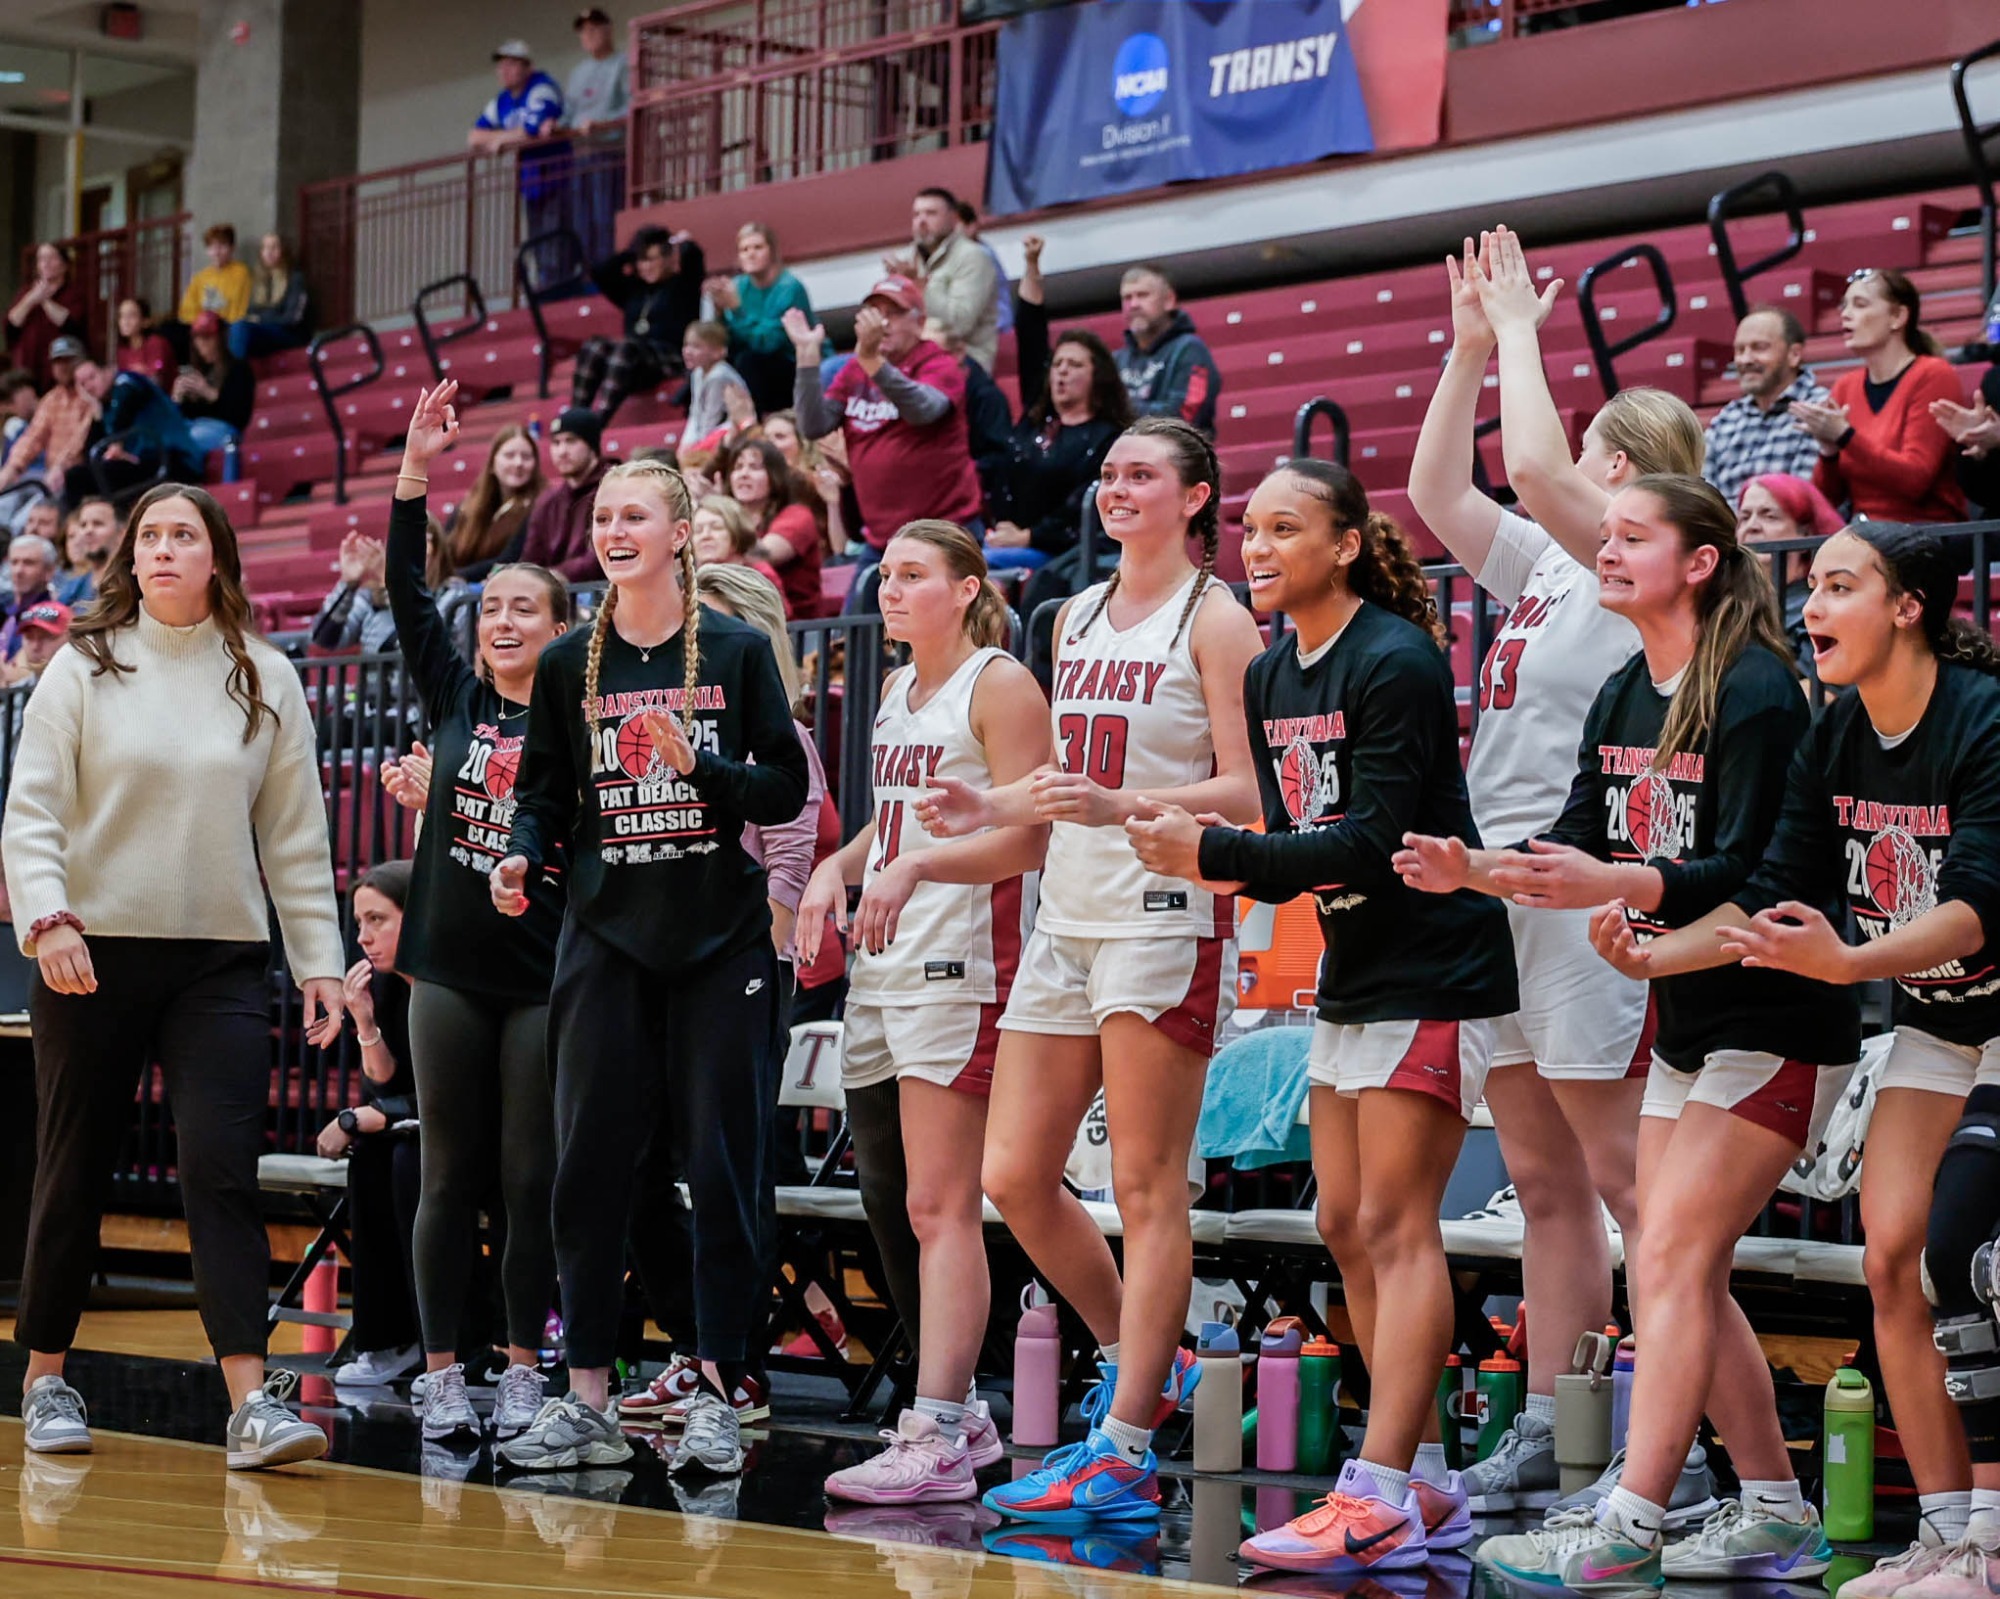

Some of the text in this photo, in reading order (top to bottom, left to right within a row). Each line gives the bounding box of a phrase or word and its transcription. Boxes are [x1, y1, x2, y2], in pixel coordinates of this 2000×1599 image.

[1208, 31, 1338, 98] TRANSY
[1114, 66, 1168, 101] NCAA
[1101, 120, 1161, 151] Division
[1054, 657, 1167, 706] TRANSY
[457, 739, 493, 785] 20
[1058, 712, 1129, 790] 30
[455, 793, 489, 821] PAT
[599, 786, 634, 810] PAT
[467, 824, 511, 853] CLAS
[614, 808, 704, 835] CLASSIC
[795, 1028, 839, 1090] T
